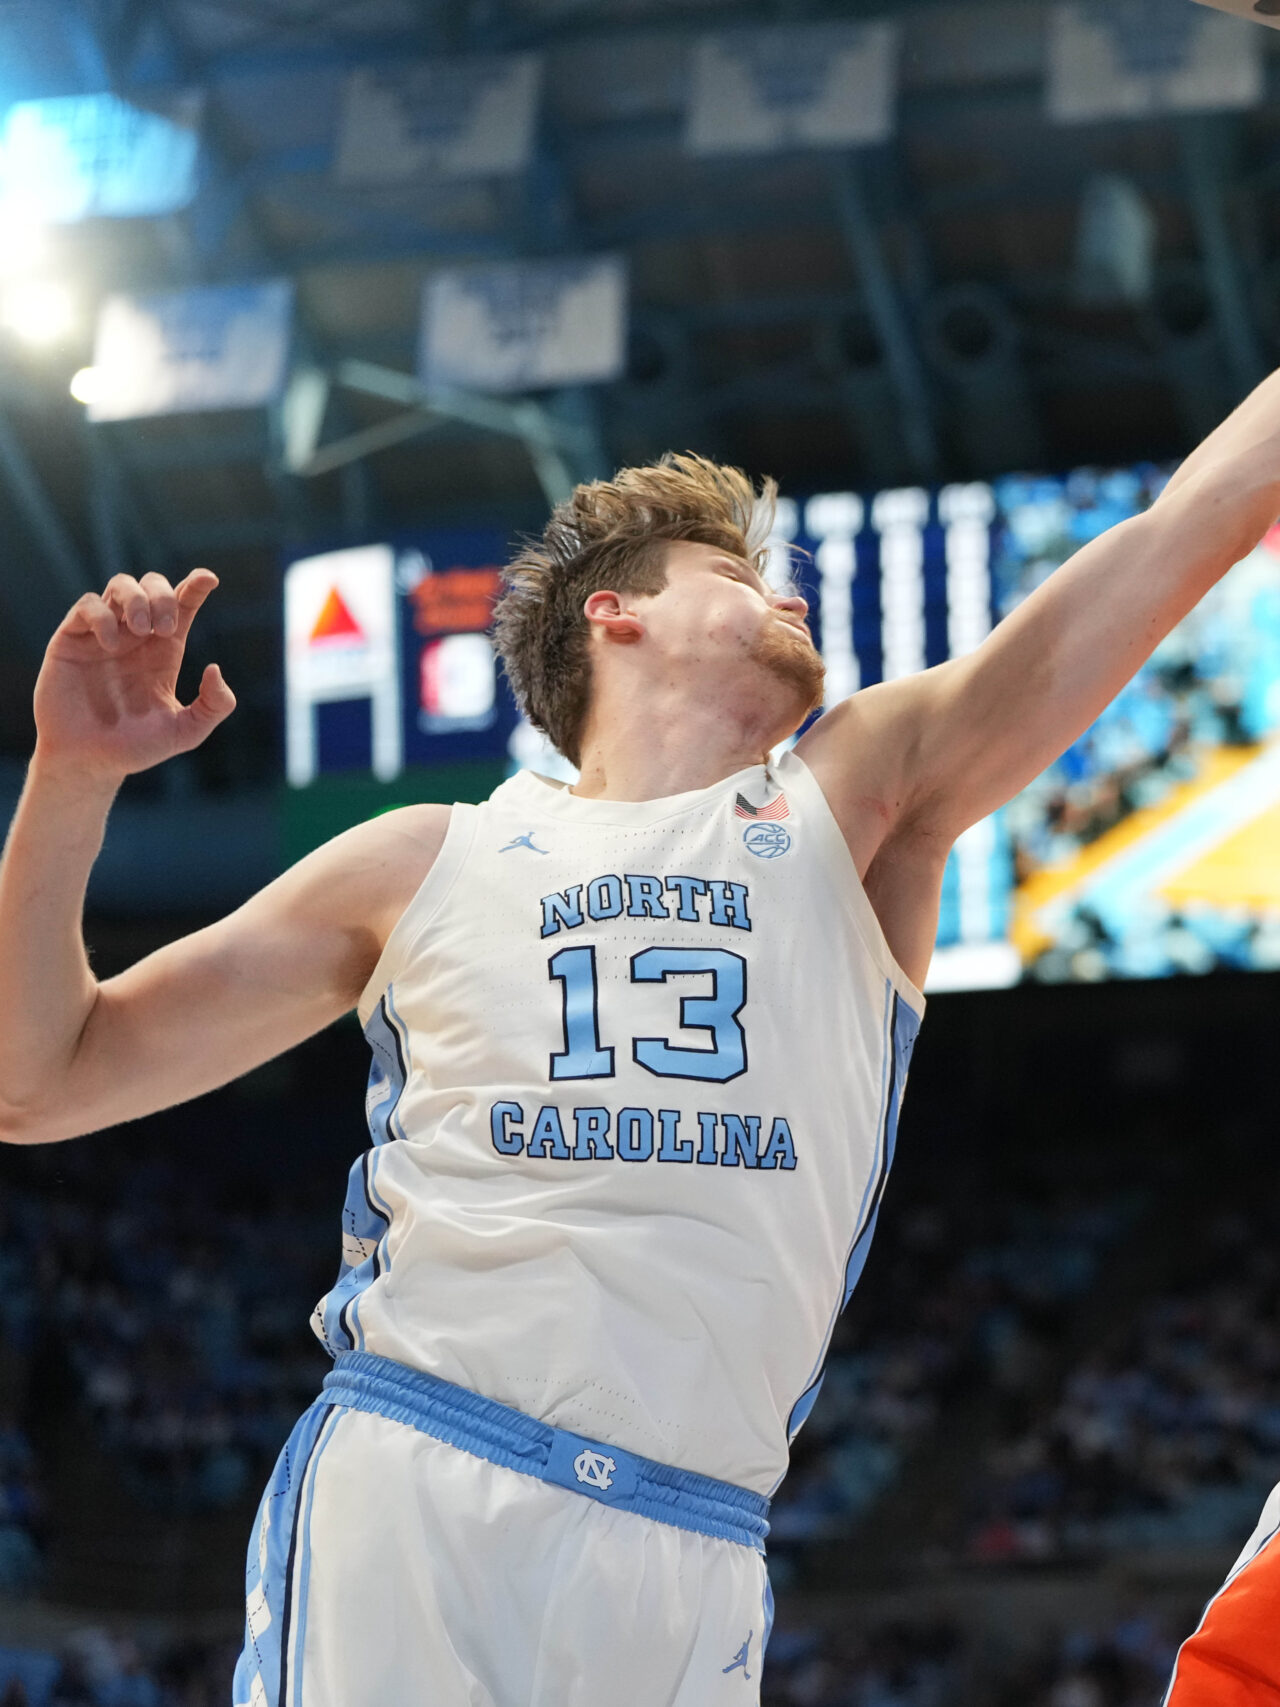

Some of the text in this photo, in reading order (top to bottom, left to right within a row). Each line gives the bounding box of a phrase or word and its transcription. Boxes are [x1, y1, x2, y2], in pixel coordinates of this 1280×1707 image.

[750, 833, 786, 844] ACC
[540, 874, 752, 939] NORTH
[548, 945, 748, 1084] 13
[491, 1101, 797, 1170] CAROLINA
